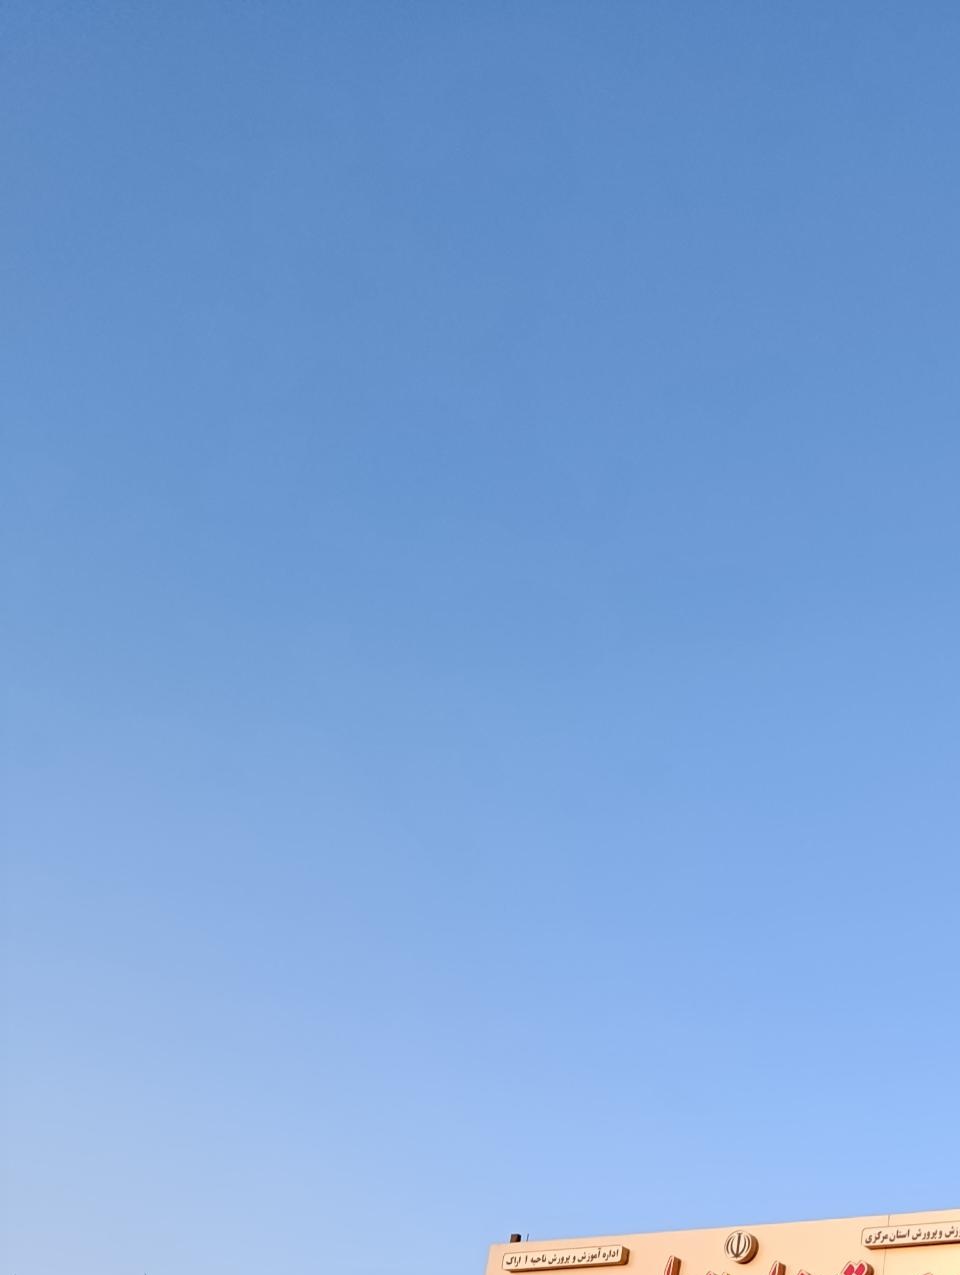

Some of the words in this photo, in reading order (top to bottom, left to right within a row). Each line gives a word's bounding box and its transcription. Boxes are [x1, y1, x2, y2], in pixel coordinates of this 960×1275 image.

[864, 1230, 889, 1244] مرکزی
[889, 1228, 911, 1242] استان
[505, 1255, 522, 1267] اراک
[530, 1253, 547, 1266] ناحیه
[547, 1254, 571, 1265] پرورش
[577, 1247, 601, 1263] آموزش
[602, 1249, 619, 1262] اداره
